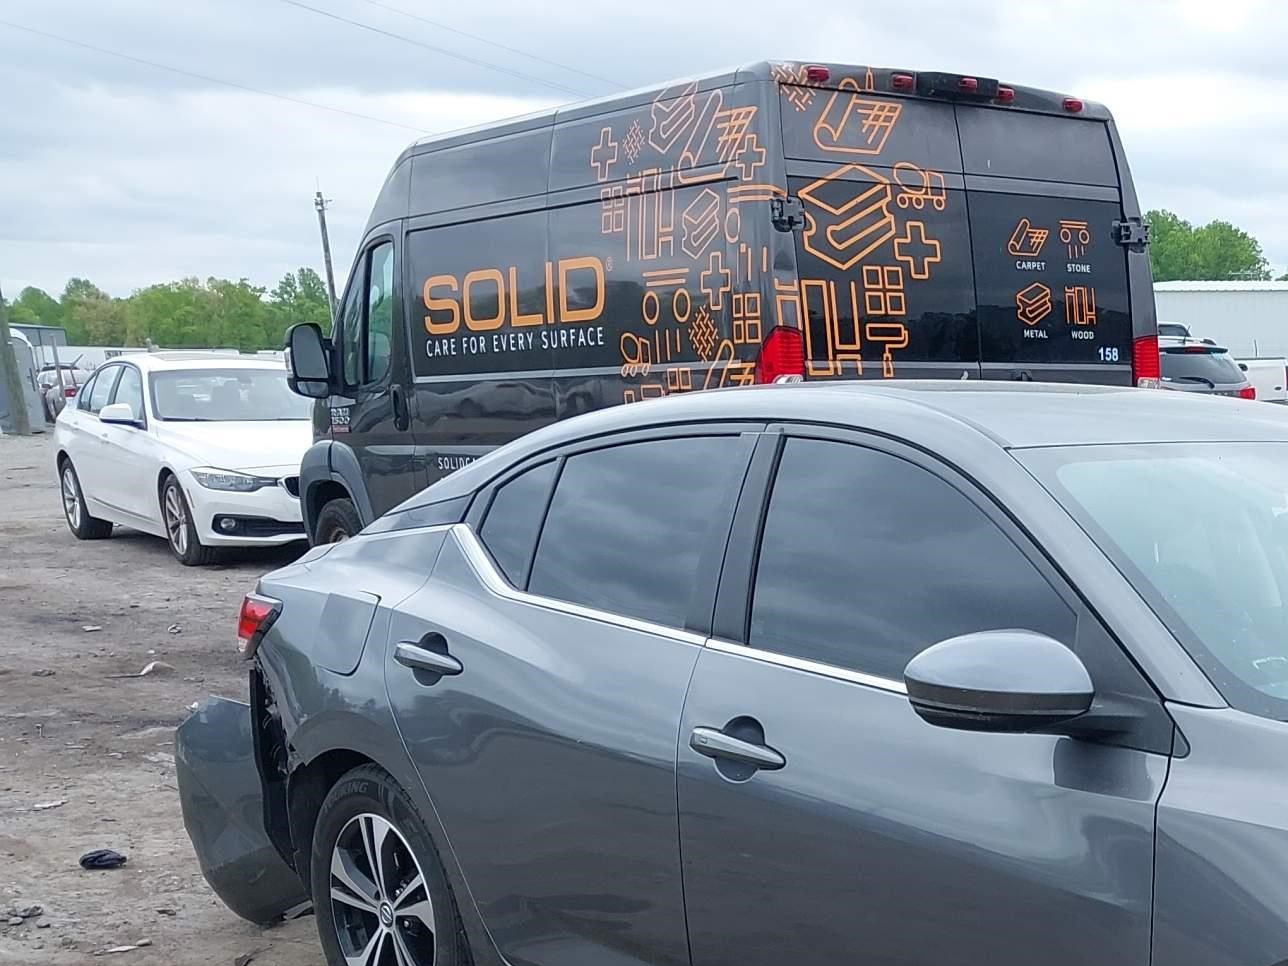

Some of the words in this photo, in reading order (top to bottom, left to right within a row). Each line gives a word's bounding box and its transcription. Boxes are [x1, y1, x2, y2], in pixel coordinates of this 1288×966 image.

[1015, 260, 1046, 271] CARPET
[1066, 263, 1091, 273] STONE
[1023, 329, 1048, 339] METAL
[1071, 330, 1095, 340] WOOD
[426, 338, 457, 357] CARE
[462, 336, 486, 355] FOR
[493, 332, 534, 352] EVERY
[541, 326, 605, 349] SURFACE
[1098, 346, 1119, 361] 158
[438, 456, 477, 470] SOLIDC
